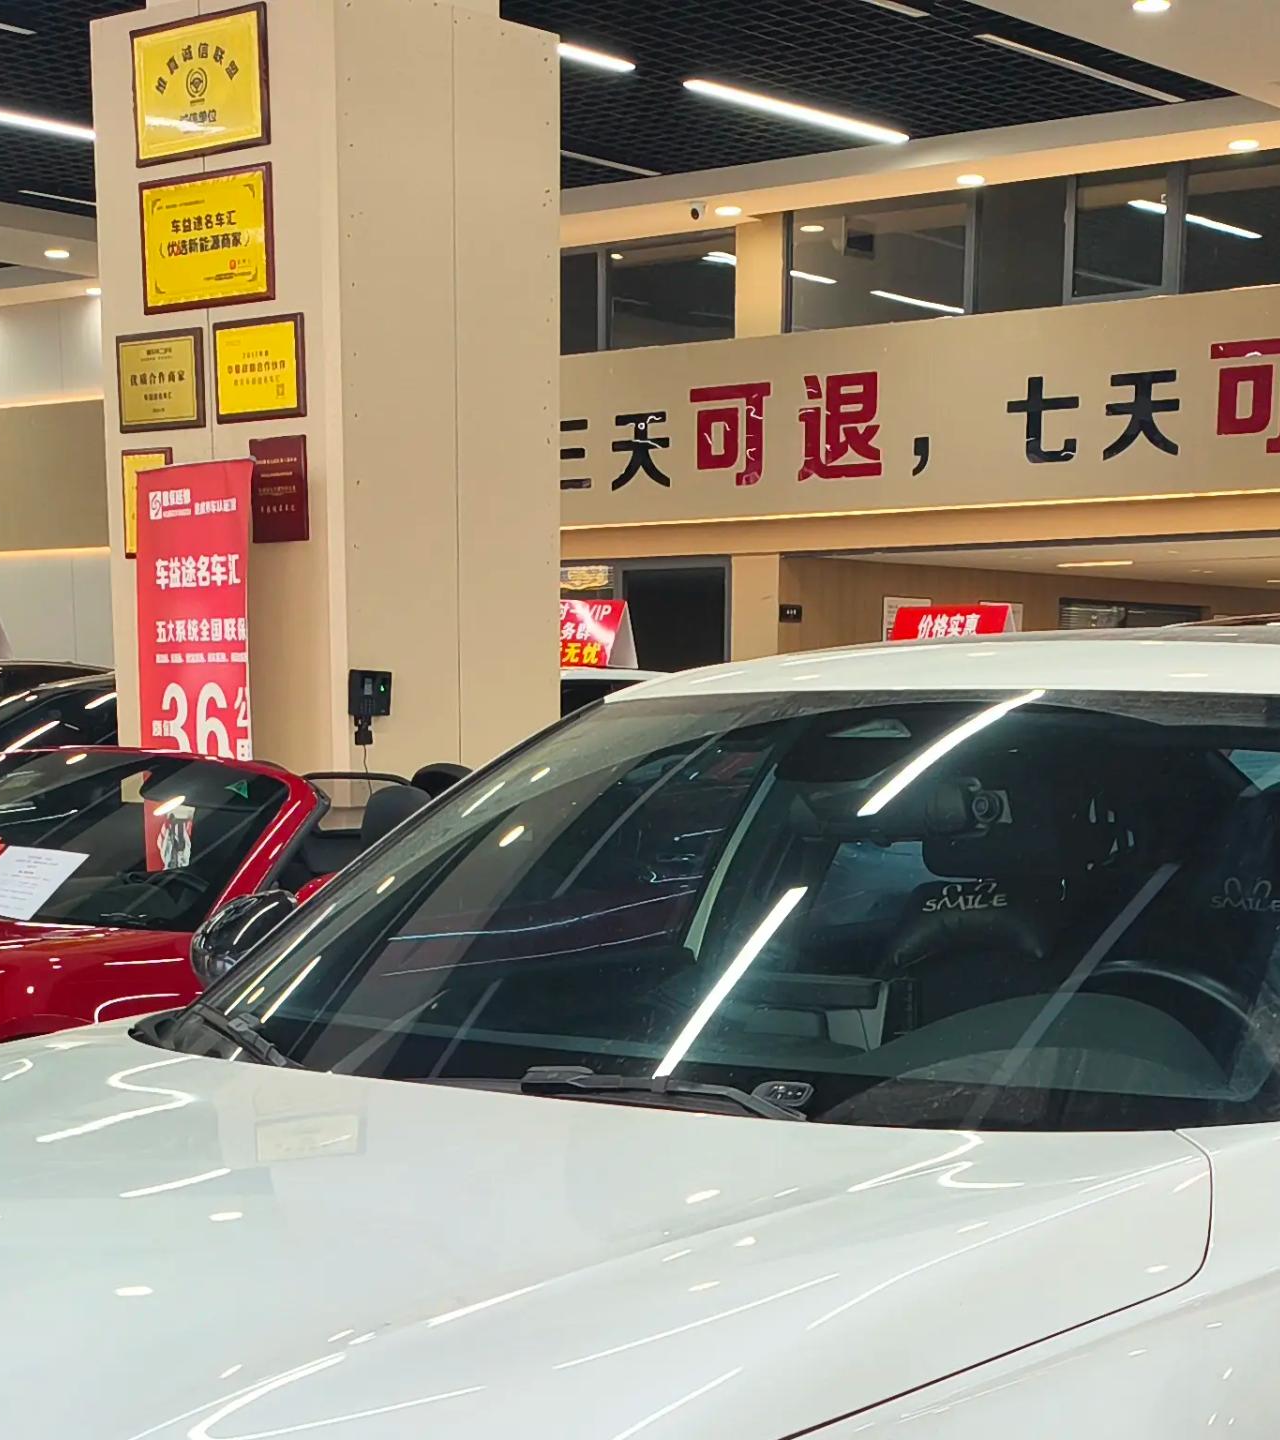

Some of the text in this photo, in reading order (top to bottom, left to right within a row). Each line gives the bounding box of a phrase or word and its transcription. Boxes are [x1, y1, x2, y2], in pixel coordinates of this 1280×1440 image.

[155, 553, 241, 590] 车益途名车汇
[917, 613, 980, 640] 价格实惠
[922, 894, 1008, 912] SMILE
